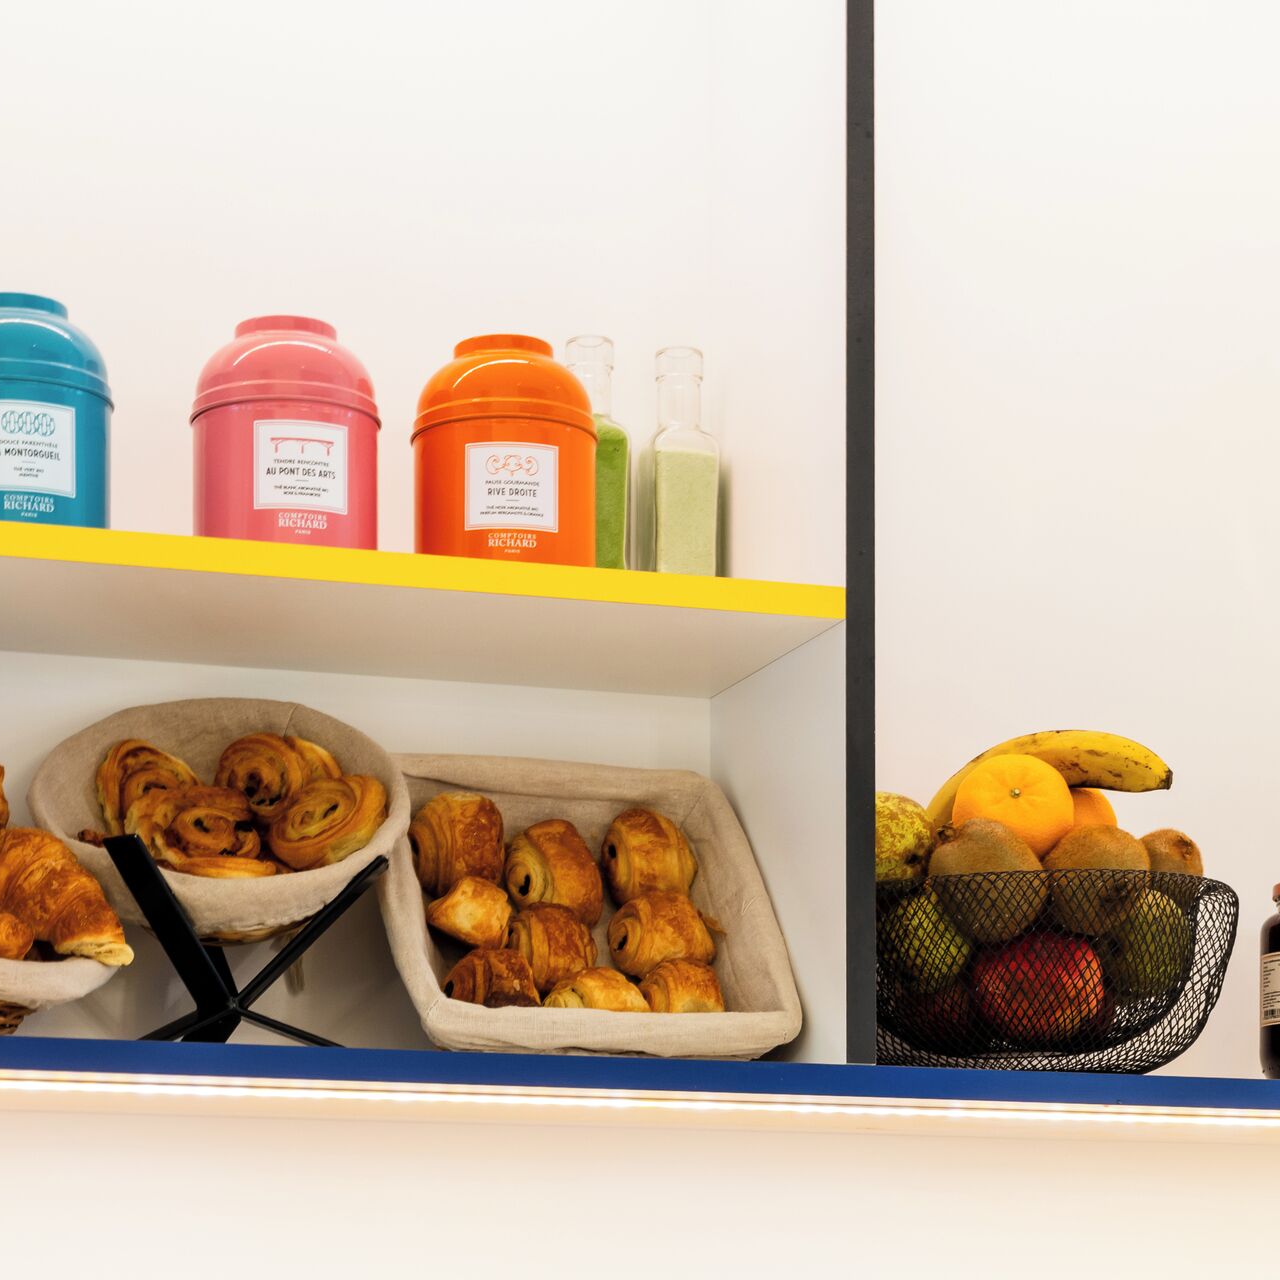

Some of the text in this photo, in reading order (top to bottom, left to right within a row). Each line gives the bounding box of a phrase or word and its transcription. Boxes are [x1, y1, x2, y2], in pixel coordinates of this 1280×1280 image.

[4, 448, 61, 462] MONTORGUEIL
[265, 467, 337, 480] AU PONT DES ARTS
[487, 487, 537, 498] RIVE DROITE
[3, 494, 55, 504] COMPTOIRS
[3, 500, 55, 513] RICHARD
[278, 512, 327, 521] COMPTOIRS
[278, 518, 327, 530] RICHARD
[487, 532, 537, 540] COMPTOIRS
[487, 538, 537, 549] RICHARD
